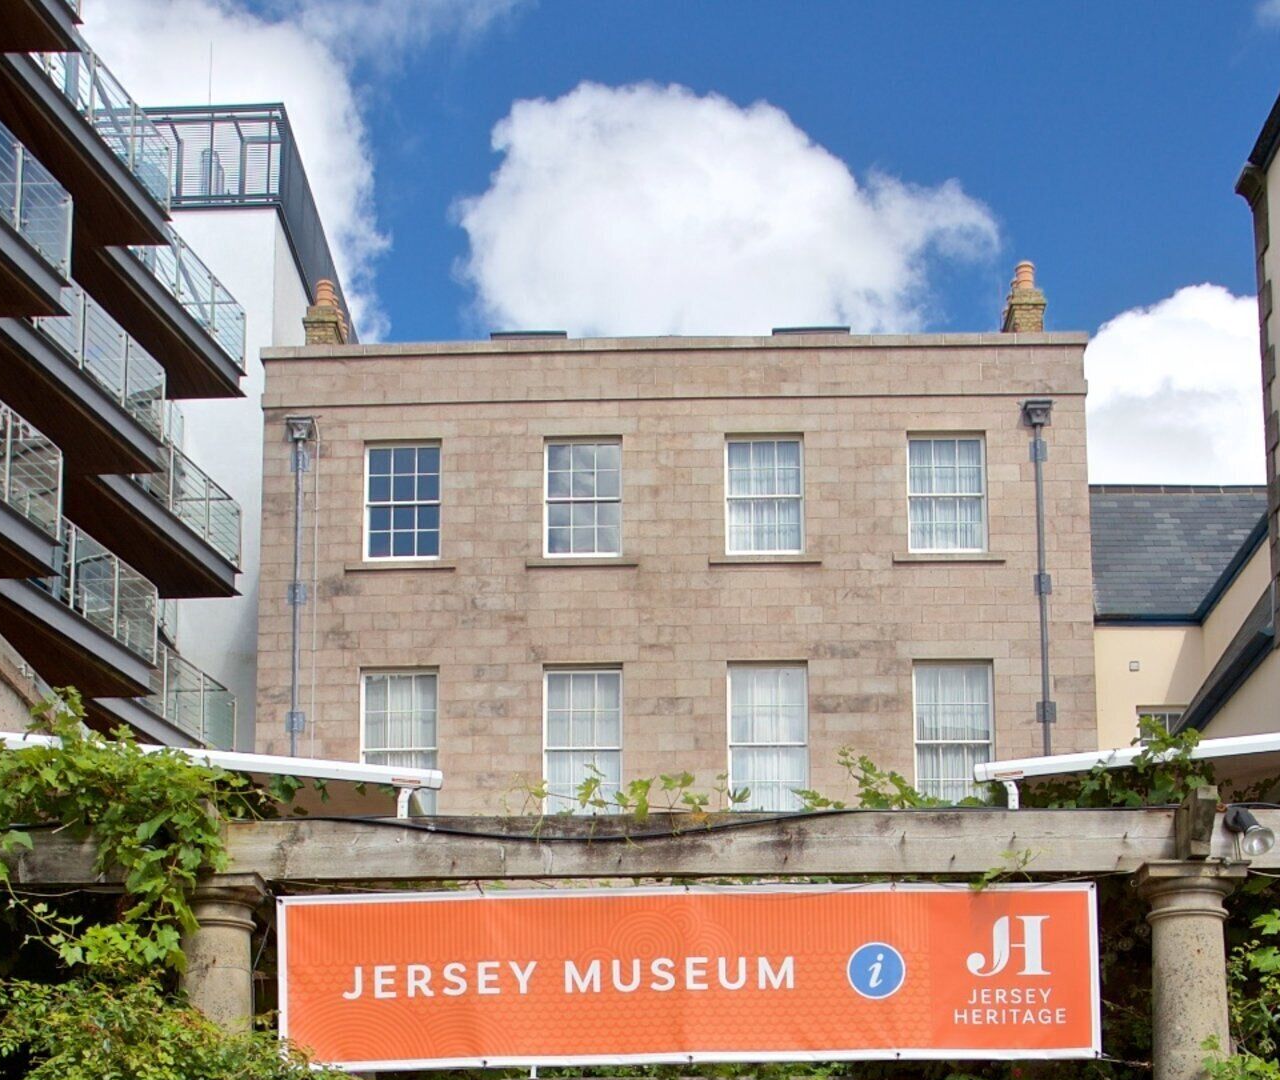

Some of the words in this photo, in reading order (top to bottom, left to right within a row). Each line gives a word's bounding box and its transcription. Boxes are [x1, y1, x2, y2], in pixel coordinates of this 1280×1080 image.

[342, 960, 538, 999] JERSEY
[564, 955, 796, 994] MUSEUM
[967, 988, 1052, 1004] JERSEY
[953, 1008, 1067, 1025] HERITAGE
